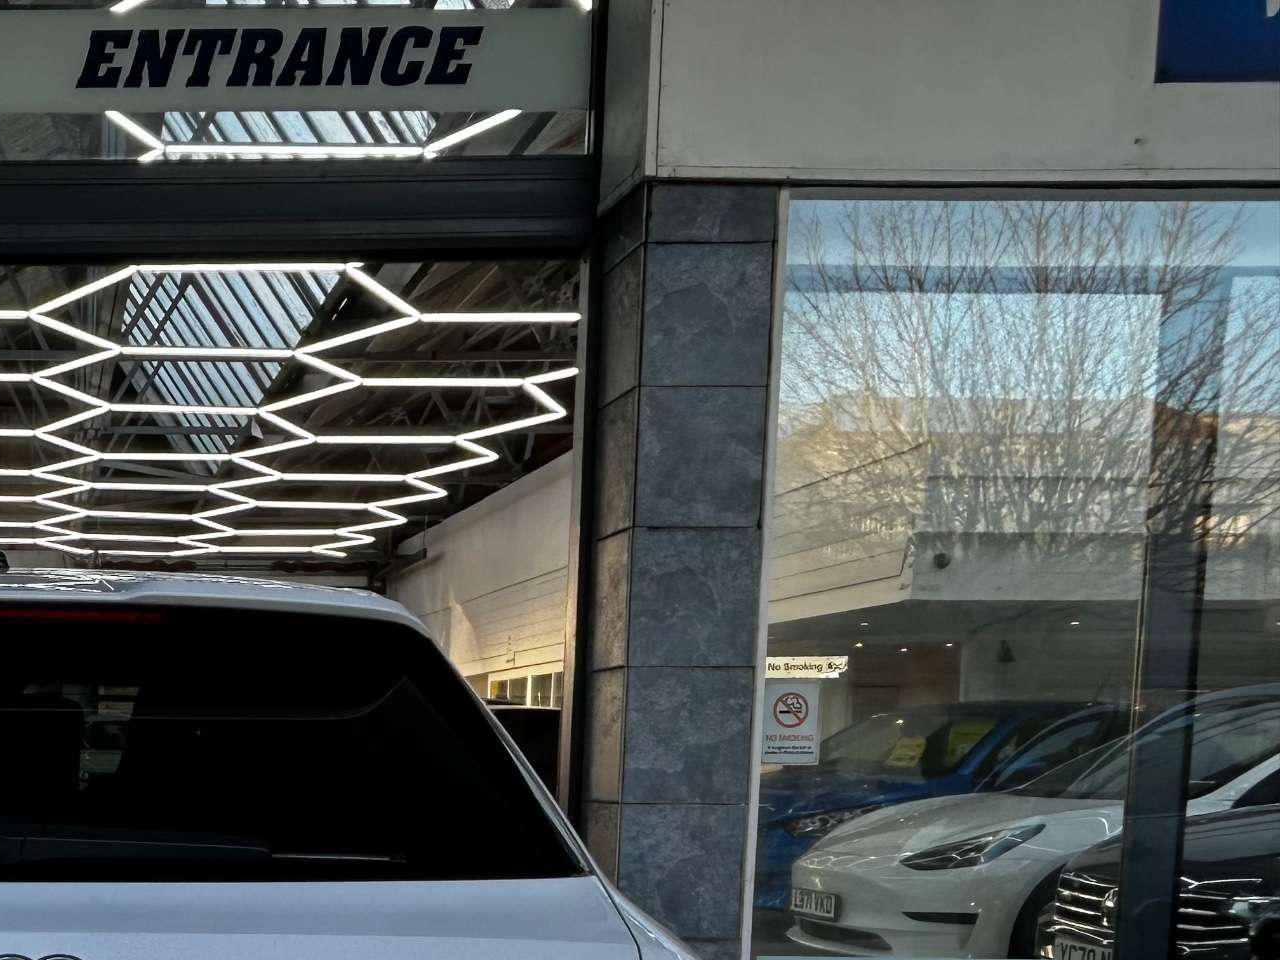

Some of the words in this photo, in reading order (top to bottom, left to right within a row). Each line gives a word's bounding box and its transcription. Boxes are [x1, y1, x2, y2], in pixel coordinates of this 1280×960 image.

[75, 25, 484, 89] ENTRANCE
[767, 662, 780, 671] No
[783, 662, 823, 673] Smoking
